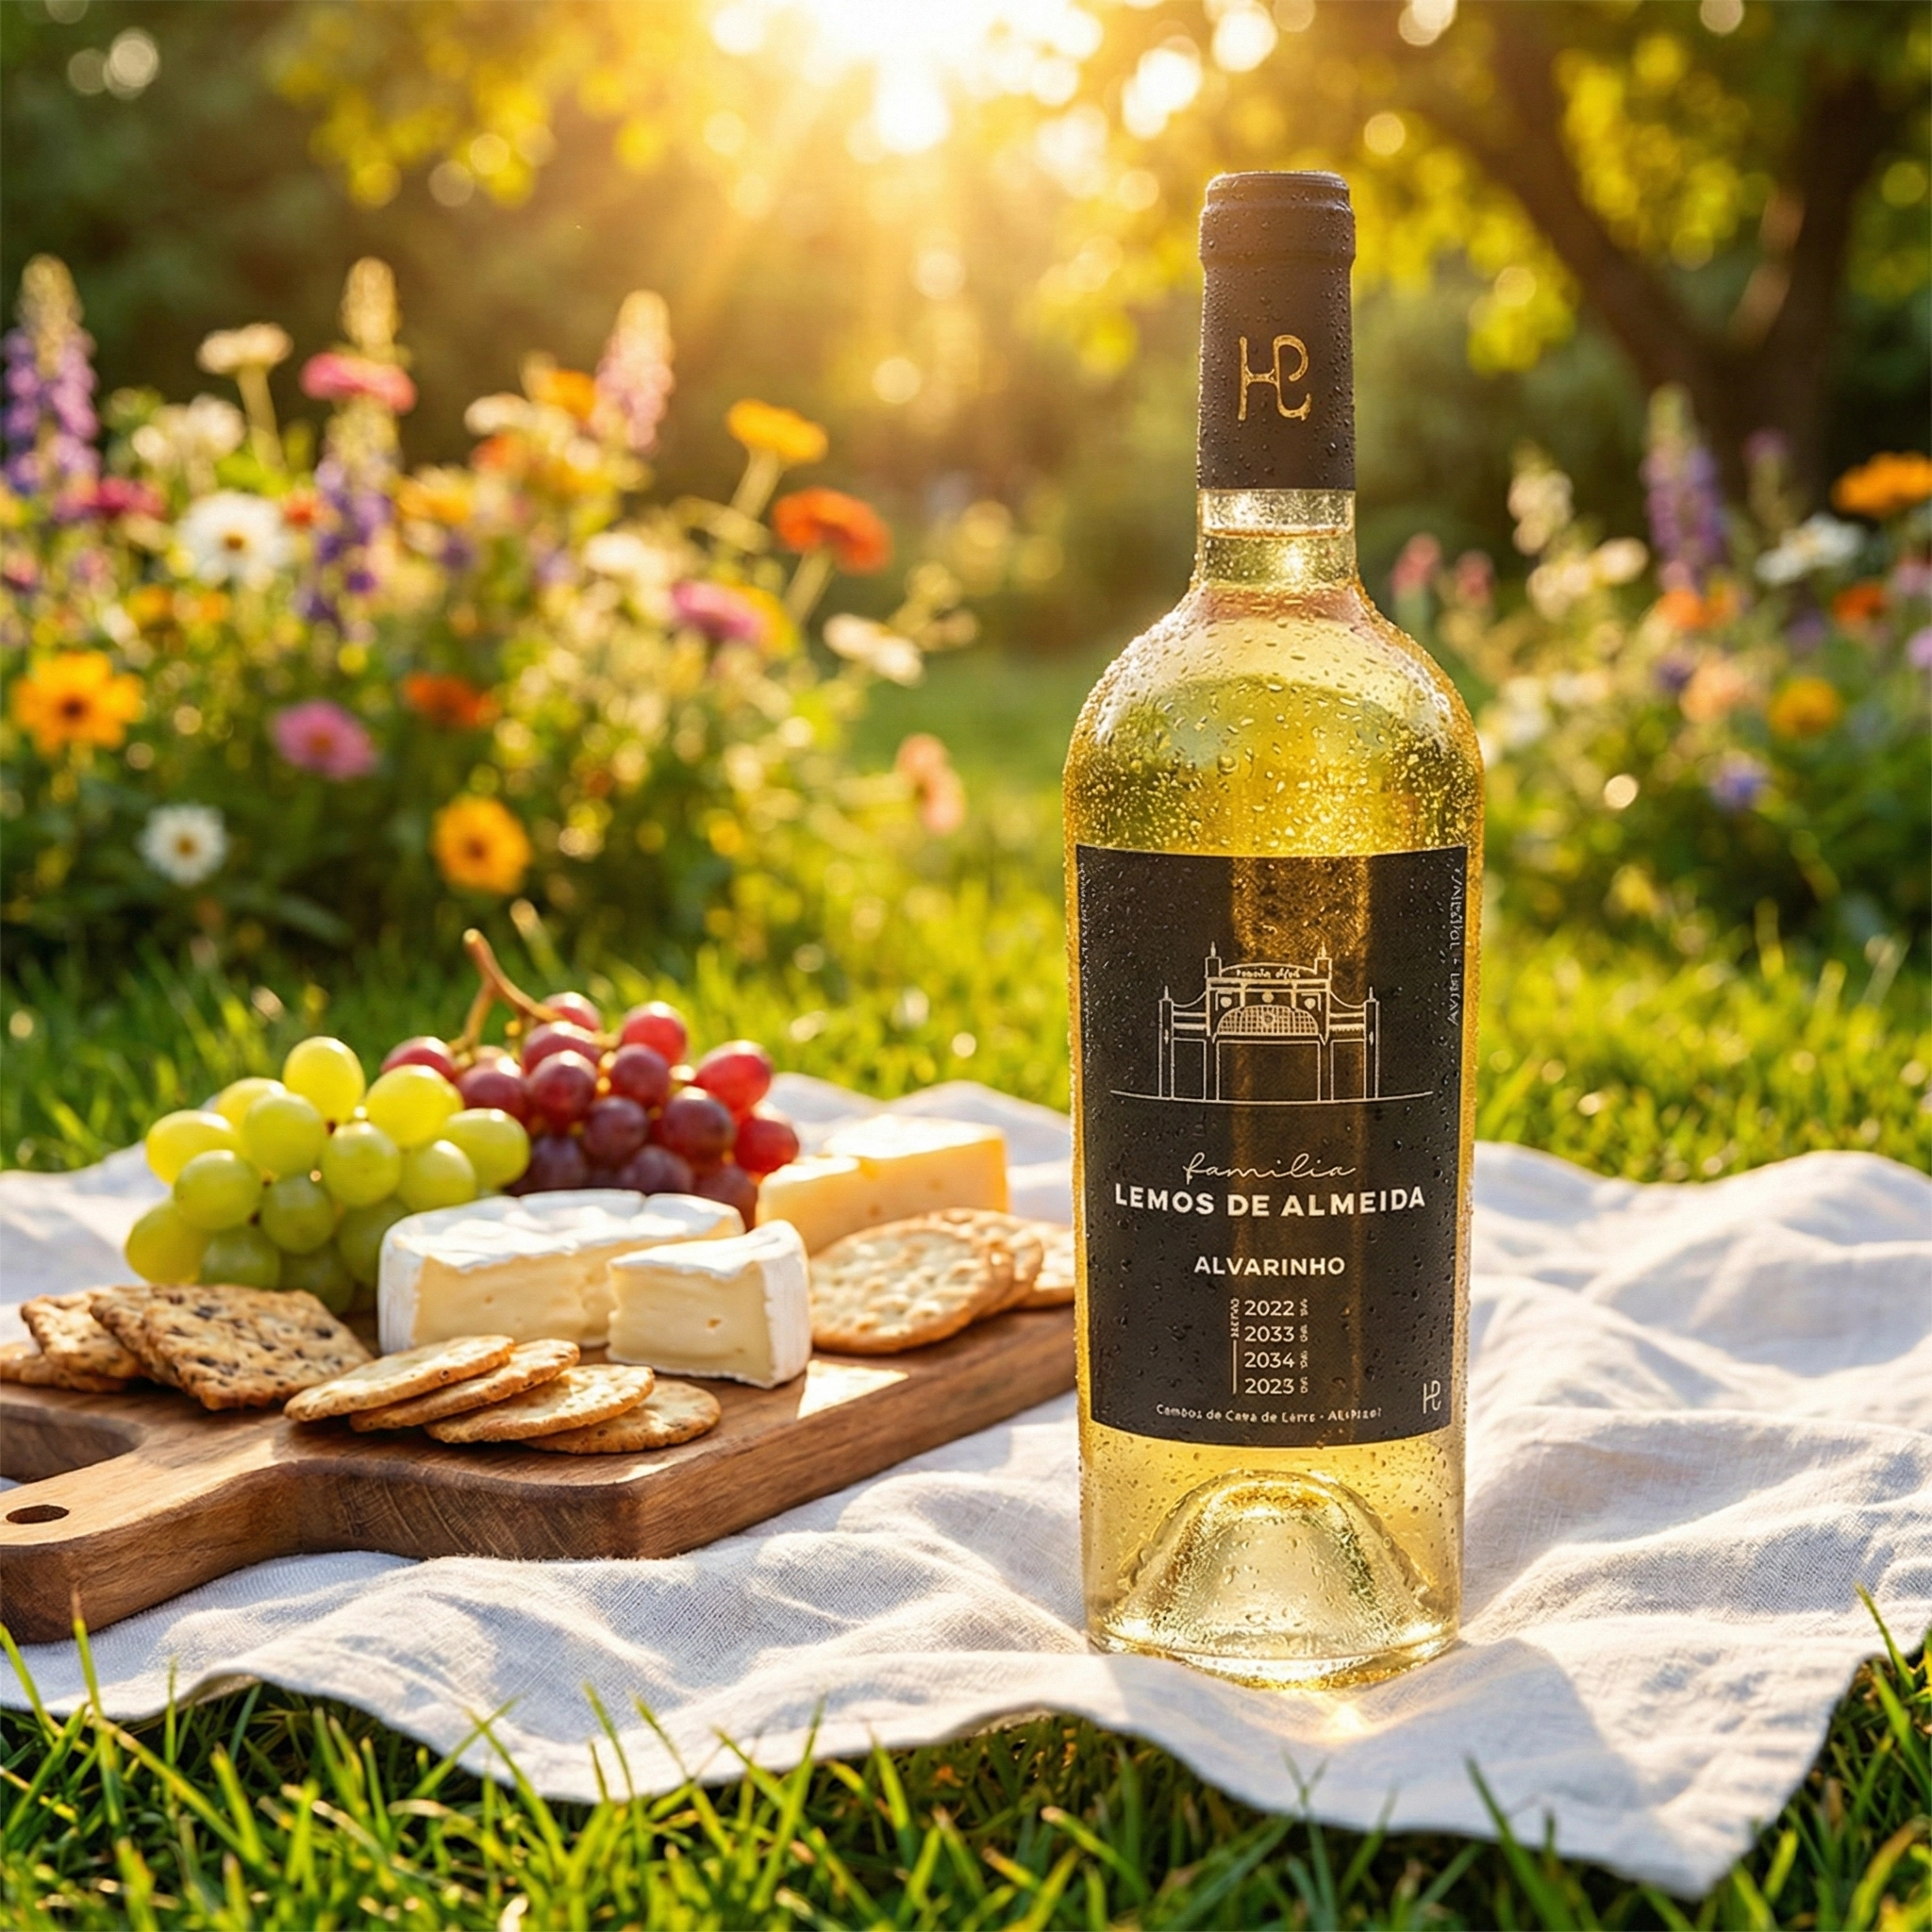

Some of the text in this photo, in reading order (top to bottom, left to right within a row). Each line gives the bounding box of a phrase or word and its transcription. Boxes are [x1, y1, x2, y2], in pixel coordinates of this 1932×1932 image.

[1183, 1152, 1357, 1185] familia
[1115, 1183, 1426, 1217] LEMOS DE ALMEIDA
[1194, 1256, 1346, 1276] ALVARINHO
[1243, 1299, 1295, 1317] 2022
[1243, 1324, 1295, 1342] 2033
[1243, 1351, 1296, 1369] 2034
[1243, 1377, 1295, 1394] 2023
